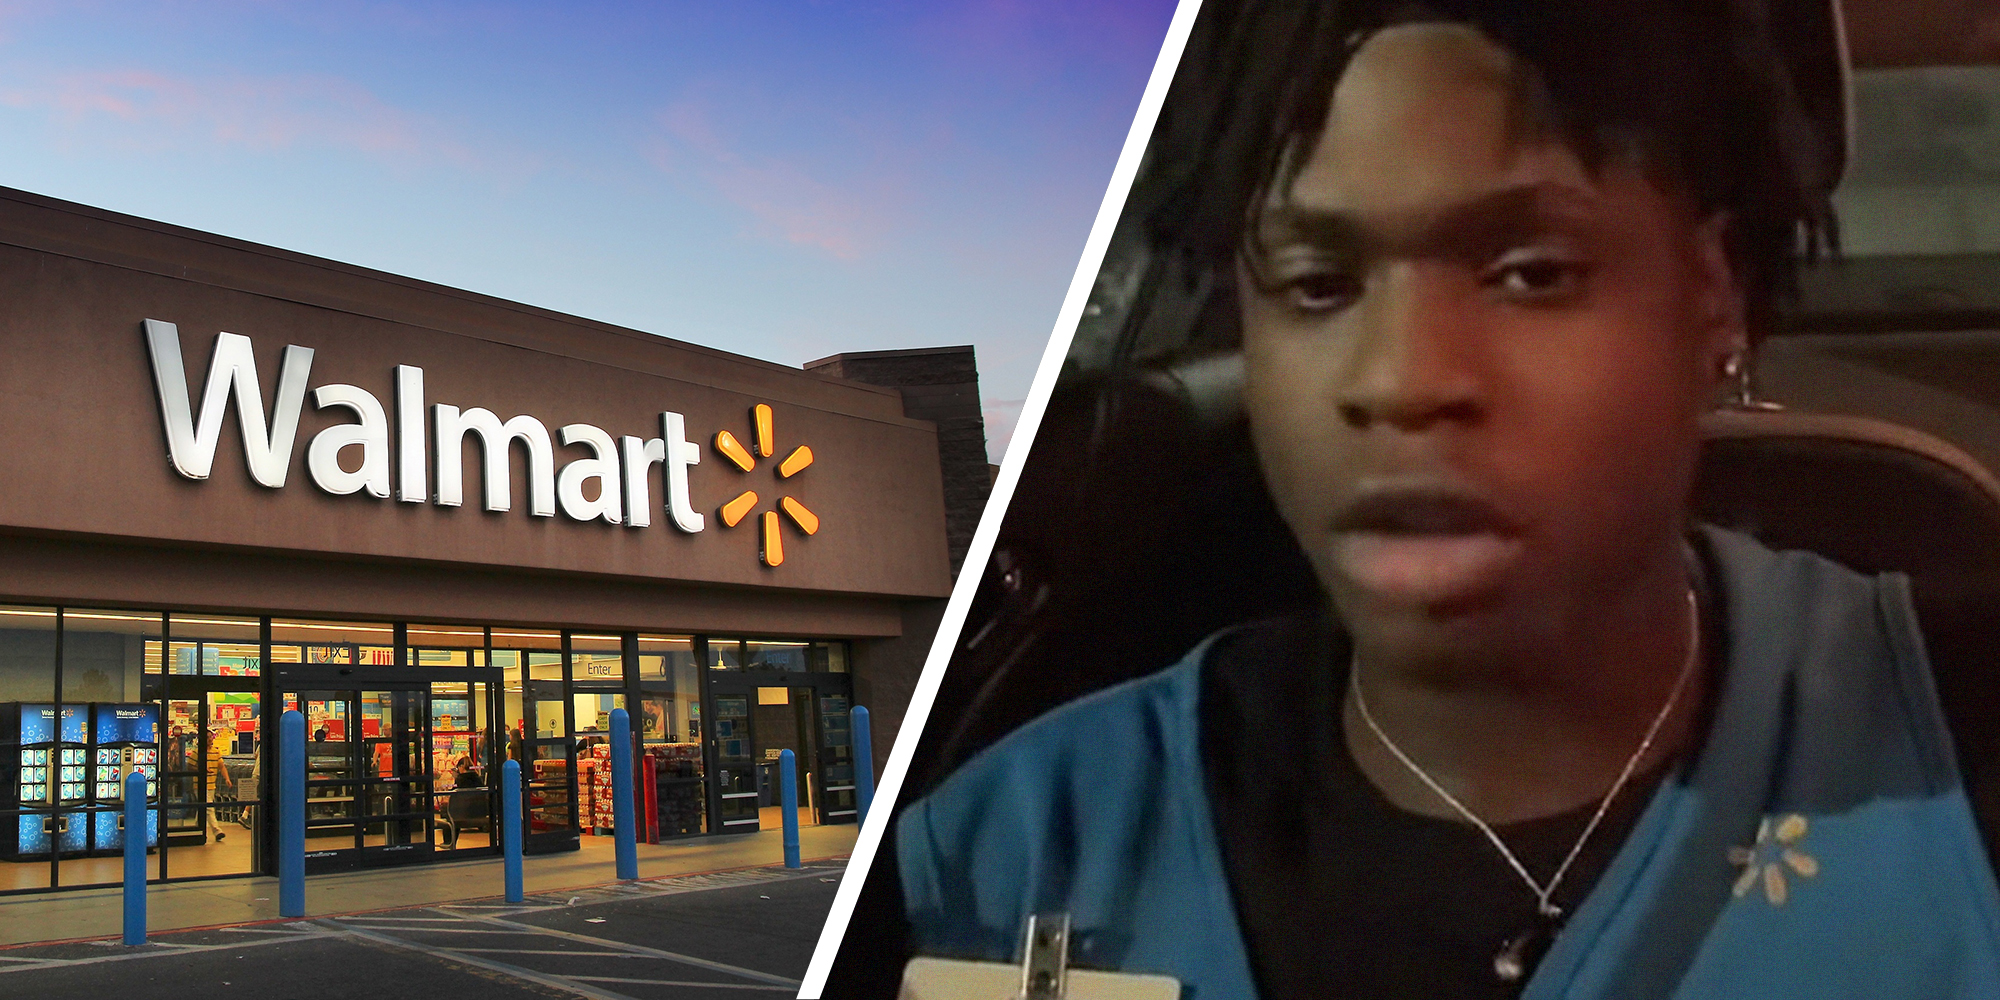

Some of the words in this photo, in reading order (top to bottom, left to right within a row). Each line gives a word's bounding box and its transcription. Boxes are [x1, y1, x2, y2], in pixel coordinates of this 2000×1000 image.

[143, 317, 706, 534] Walmart
[766, 651, 790, 664] Enter
[587, 662, 612, 675] Enter
